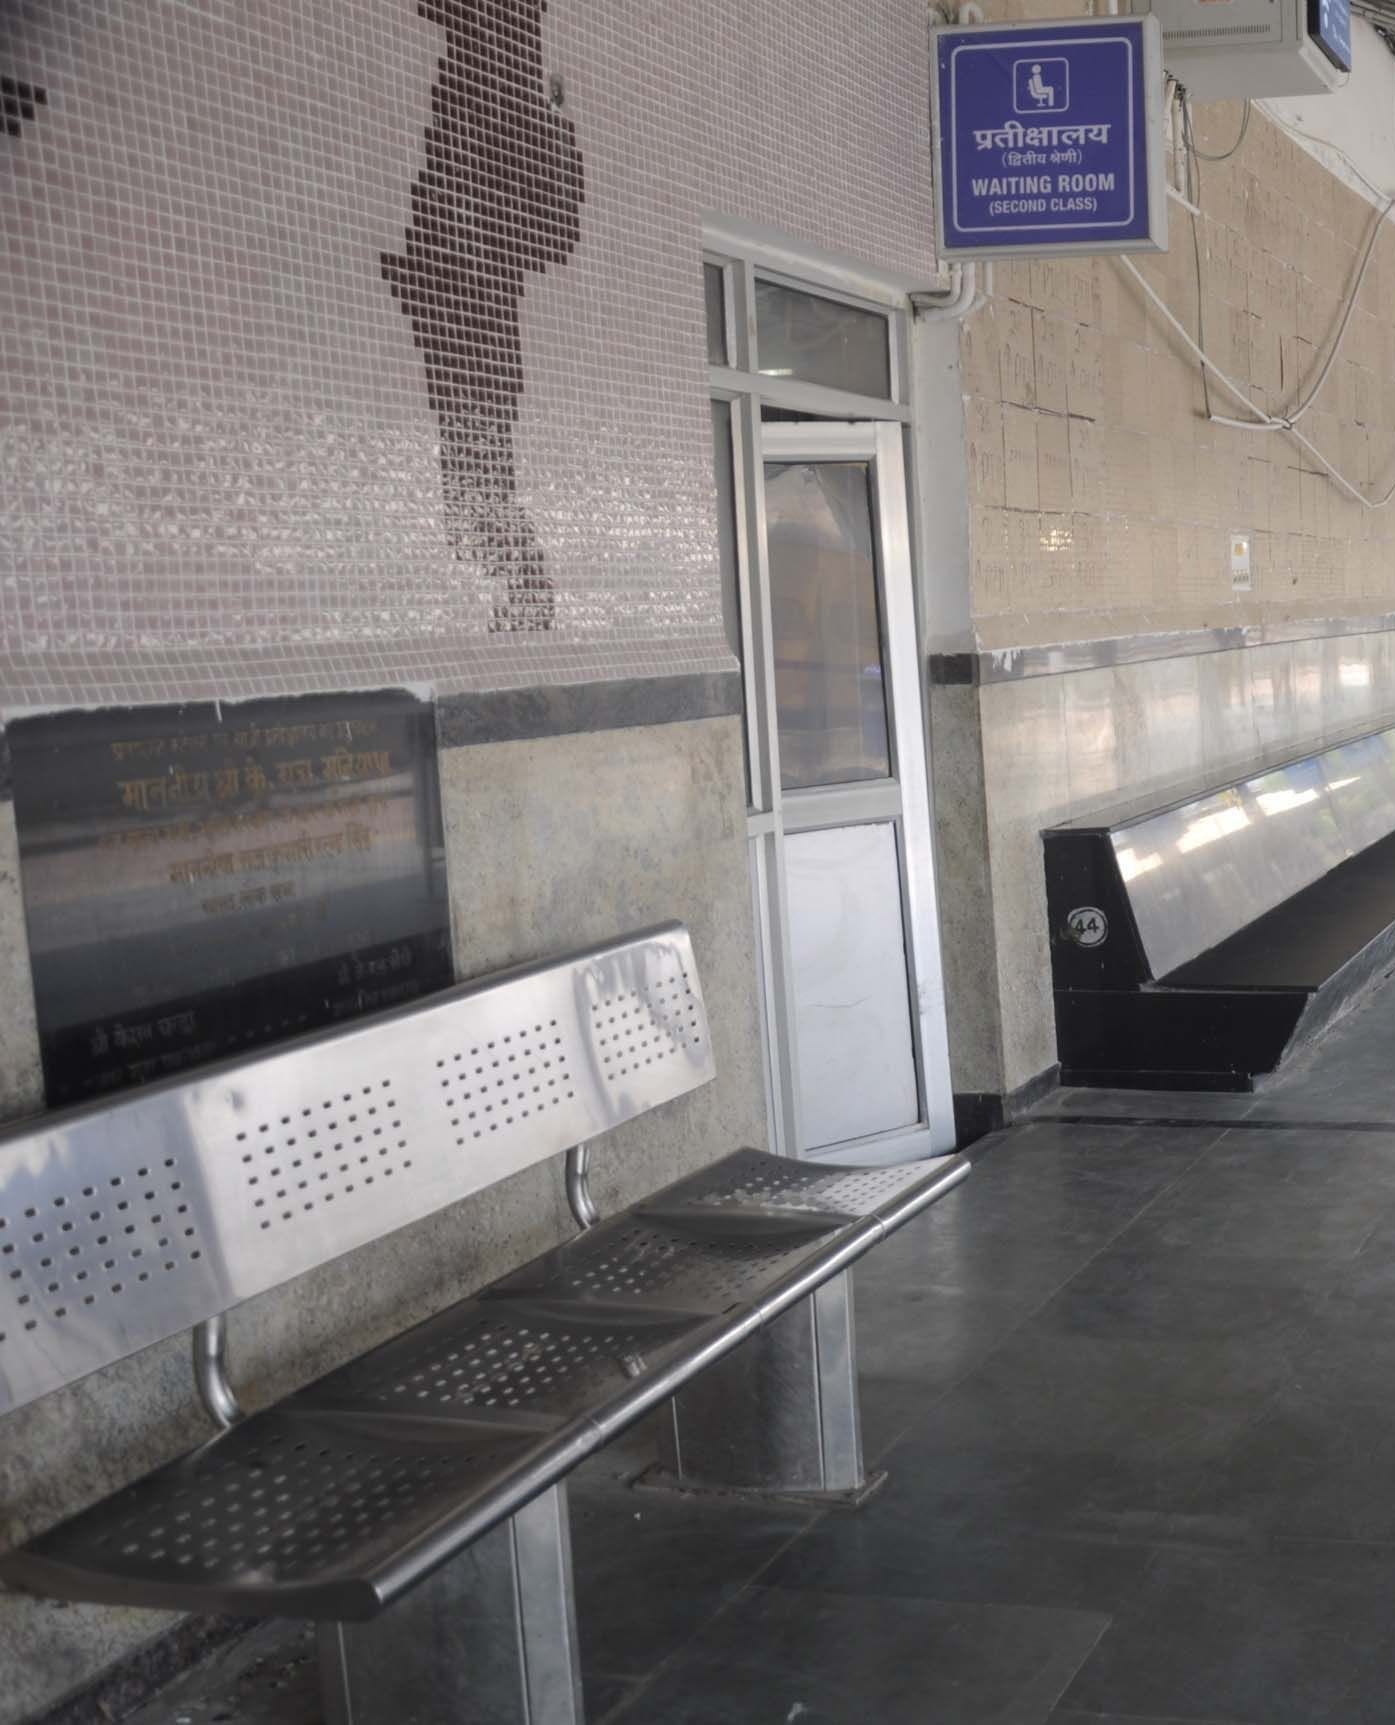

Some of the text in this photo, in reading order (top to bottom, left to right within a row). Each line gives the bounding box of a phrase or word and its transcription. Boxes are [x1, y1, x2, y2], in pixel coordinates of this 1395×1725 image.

[972, 120, 1111, 150] प्रतीक्षालय
[1001, 148, 1082, 168] (द्वितीय श्रेणी)
[971, 172, 1115, 196] WAITING ROOM
[989, 197, 1097, 216] (SECOND CLASS)
[1074, 917, 1100, 935] 44
